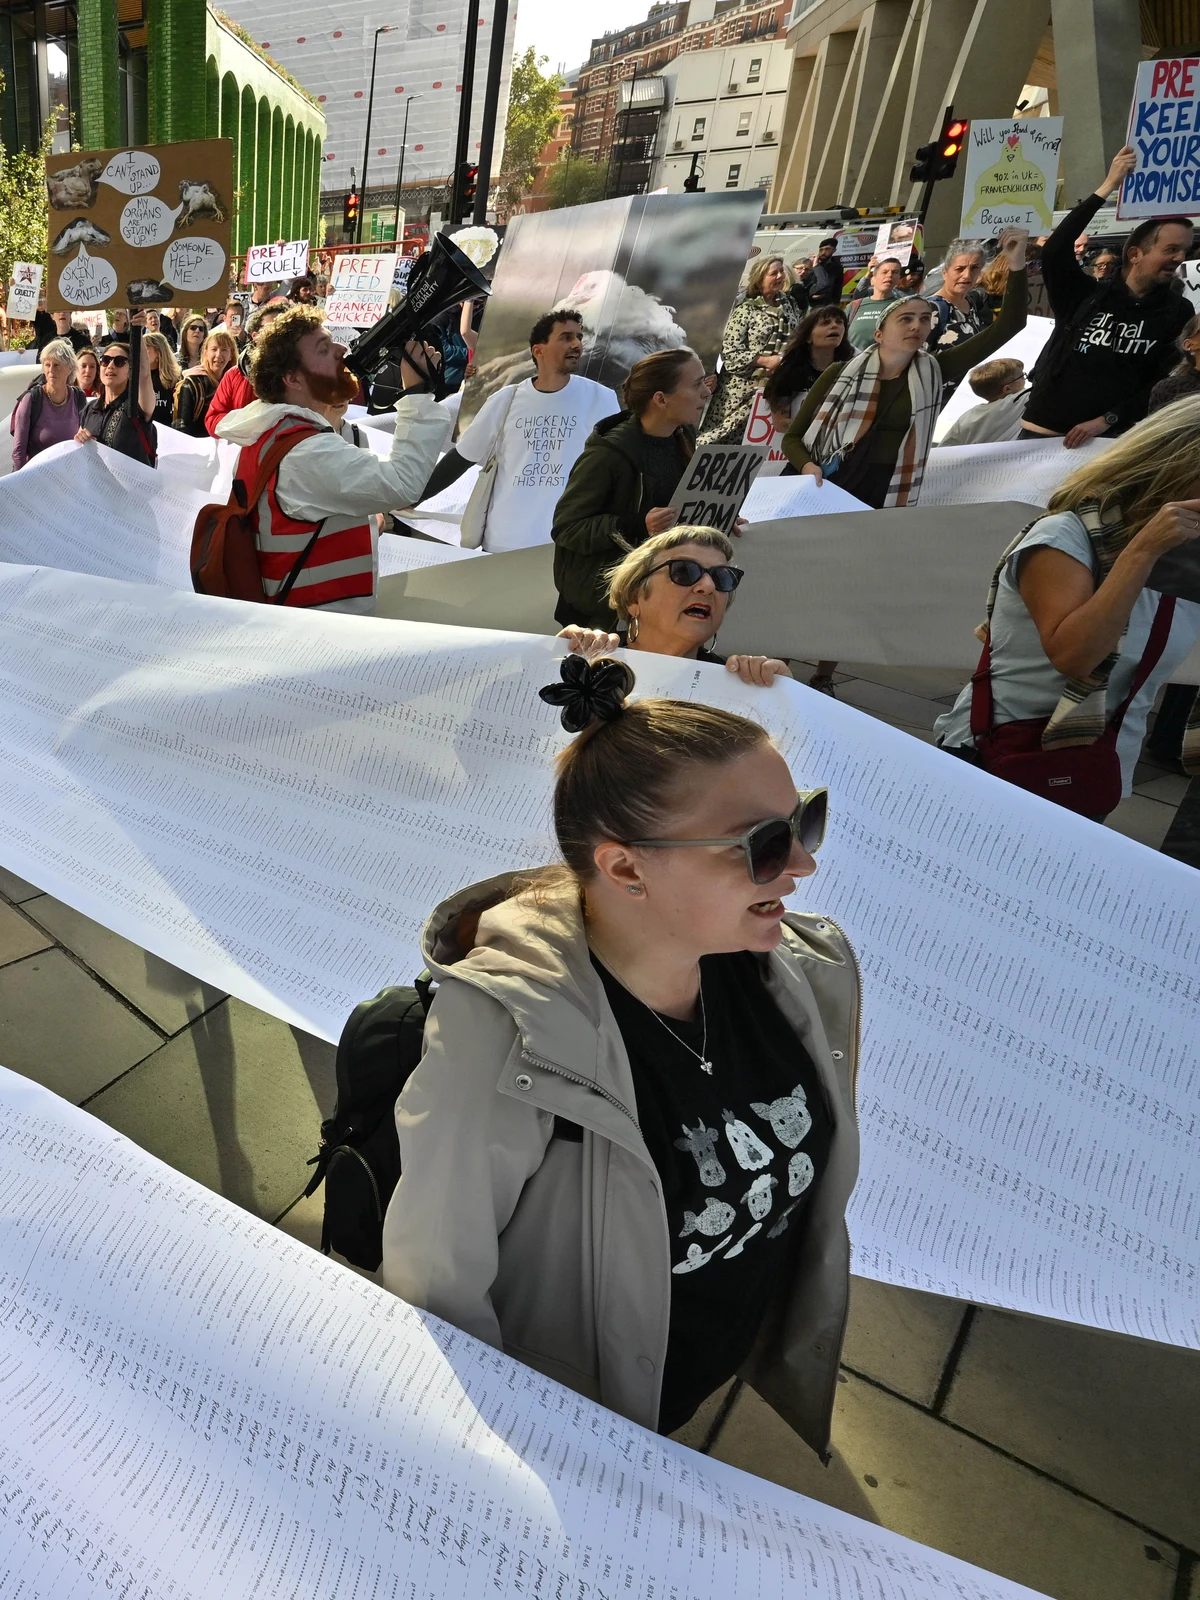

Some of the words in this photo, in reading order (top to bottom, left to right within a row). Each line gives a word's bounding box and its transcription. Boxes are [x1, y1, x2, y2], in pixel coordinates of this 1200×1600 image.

[1151, 59, 1200, 98] PRE
[973, 127, 994, 147] Will
[126, 152, 136, 163] I
[1137, 134, 1200, 168] YOUR
[130, 164, 159, 182] STAND
[137, 198, 149, 209] MY
[124, 207, 162, 220] ORGANS
[1026, 212, 1034, 222] I
[122, 223, 158, 238] GIVING
[172, 240, 214, 256] SOMEONE
[77, 256, 90, 269] MY
[170, 254, 203, 268] HELP
[250, 257, 302, 277] CRUEL
[338, 258, 387, 274] PRET
[398, 259, 416, 268] PRE
[62, 264, 95, 282] SKIN
[334, 275, 381, 290] LIED
[62, 277, 111, 305] BURNING
[413, 281, 439, 312] EQUALITY
[328, 302, 382, 312] FRANKEN
[328, 312, 382, 322] CHICKEN
[516, 415, 577, 428] CHICKENS
[527, 440, 564, 451] MEANT
[534, 452, 550, 462] TO
[522, 463, 563, 476] GROW
[686, 452, 764, 496] BREAK
[512, 476, 536, 486] THIS
[539, 476, 565, 486] FAST
[388, 1489, 401, 1521] Caroline
[454, 1523, 472, 1552] Lesley
[516, 1550, 529, 1577] Linda
